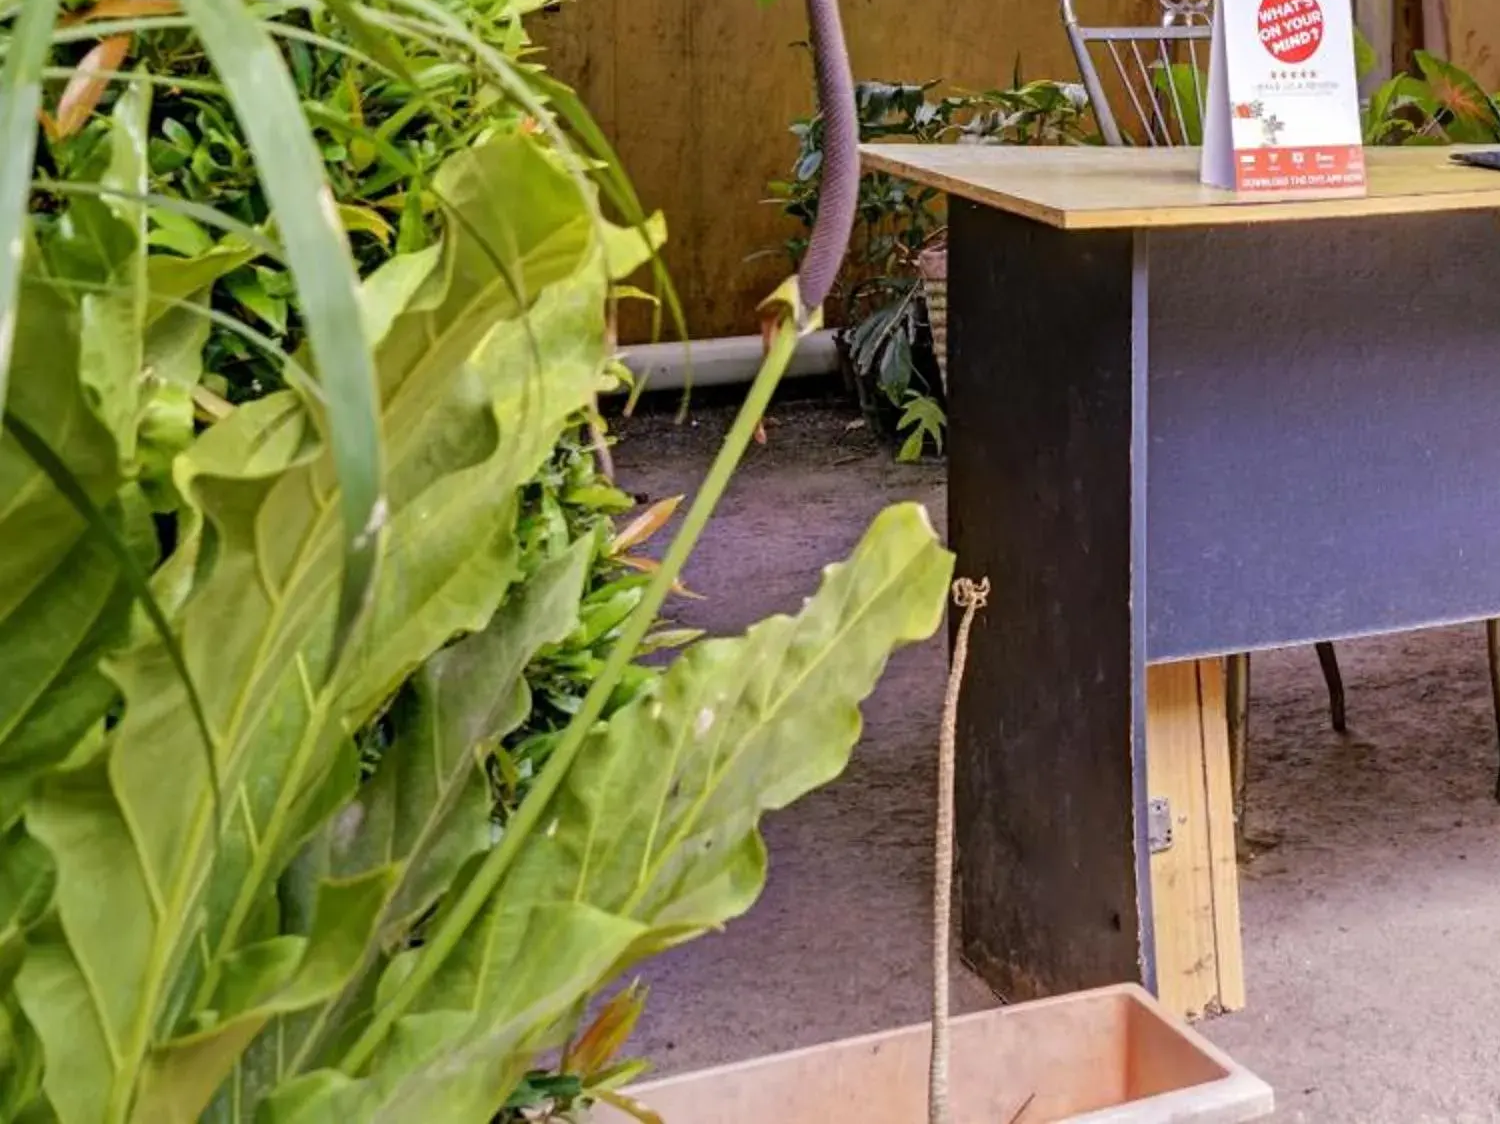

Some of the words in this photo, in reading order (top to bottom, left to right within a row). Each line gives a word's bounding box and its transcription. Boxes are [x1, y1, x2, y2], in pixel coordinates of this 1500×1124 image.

[1260, 23, 1282, 41] ON
[1283, 10, 1322, 33] YOUR
[1271, 27, 1320, 54] MIND?
